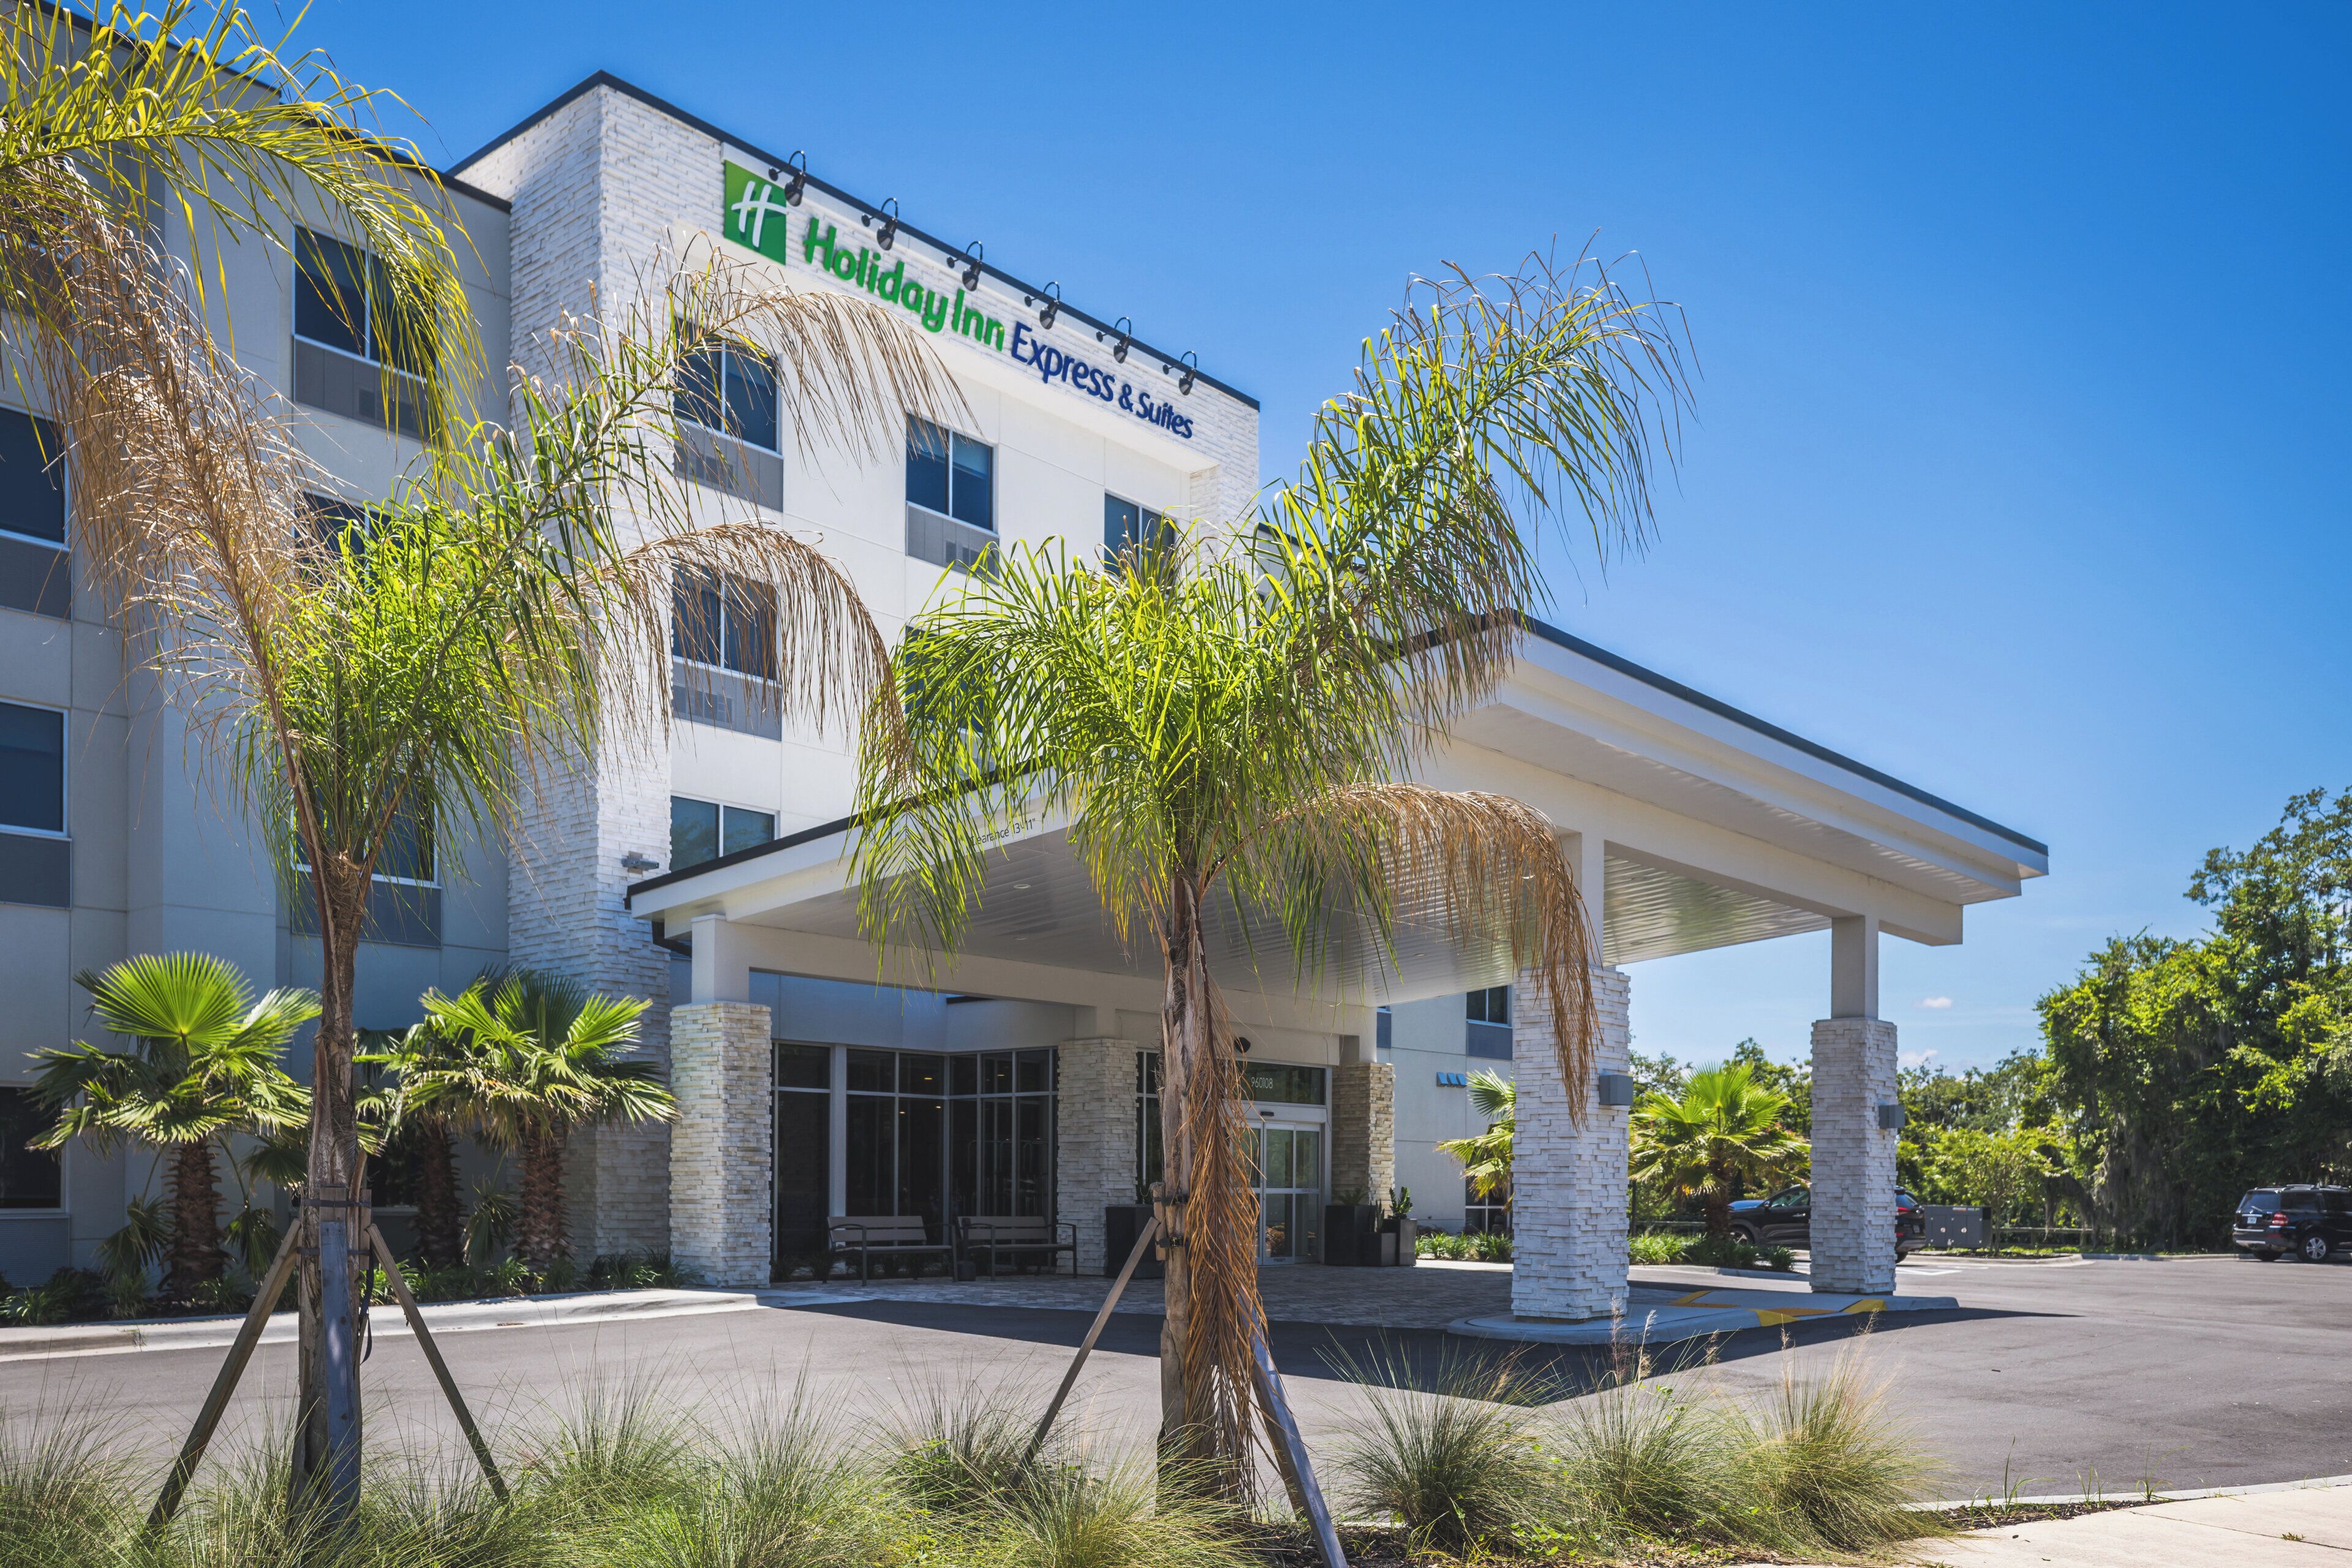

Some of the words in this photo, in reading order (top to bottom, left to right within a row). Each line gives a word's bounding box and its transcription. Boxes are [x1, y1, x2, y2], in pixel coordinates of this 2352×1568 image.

[802, 216, 948, 333] Holiday
[951, 288, 1005, 352] Inn
[1012, 321, 1115, 402] Express
[1118, 383, 1133, 412] &
[1136, 392, 1193, 439] Suites
[1251, 1077, 1273, 1089] 960108
